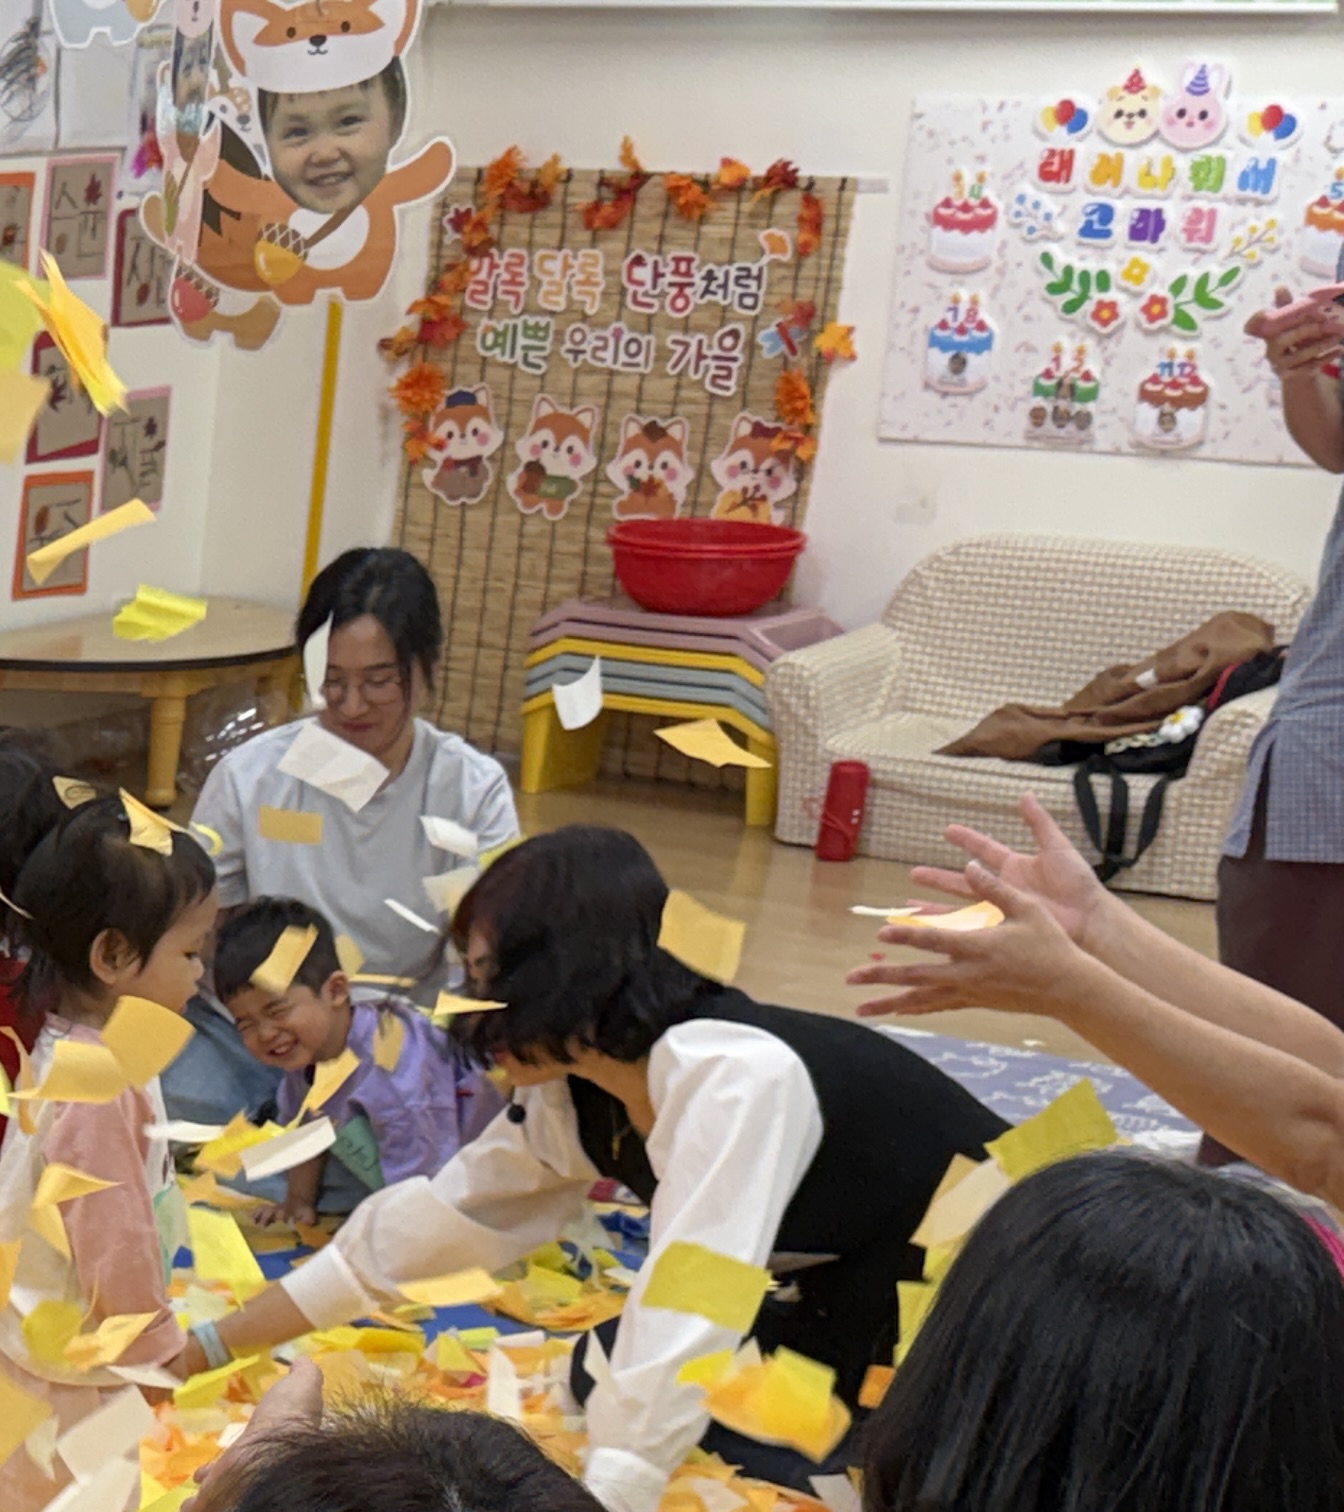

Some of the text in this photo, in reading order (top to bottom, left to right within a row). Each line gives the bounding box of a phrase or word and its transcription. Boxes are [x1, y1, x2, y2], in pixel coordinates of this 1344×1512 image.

[1077, 202, 1218, 245] 고마워
[625, 254, 764, 314] 단풍처럼
[480, 318, 742, 392] 예쁜 우리의 가을
